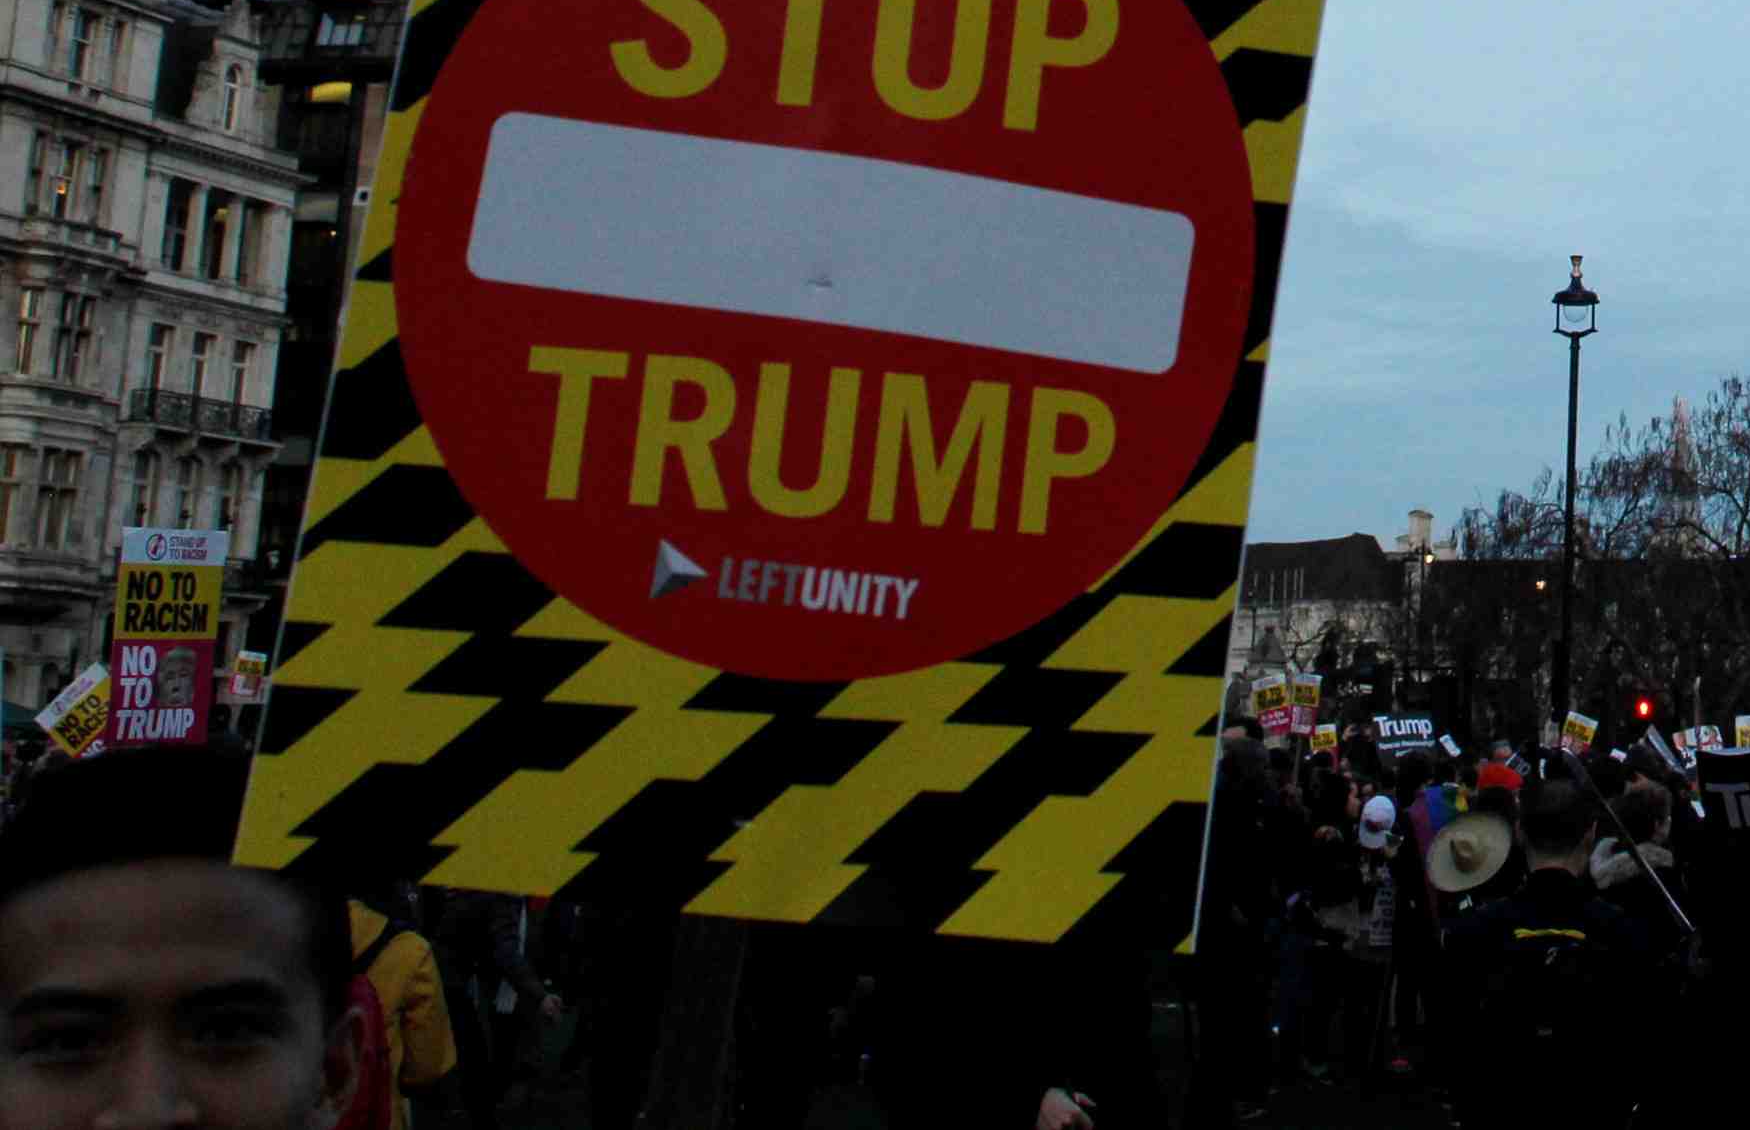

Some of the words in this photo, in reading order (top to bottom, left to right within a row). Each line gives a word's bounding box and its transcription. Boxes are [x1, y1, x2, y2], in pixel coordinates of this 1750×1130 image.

[528, 345, 1116, 534] TRUMP
[128, 571, 162, 600] NO
[173, 573, 196, 600] TO
[124, 603, 208, 632] RACISM
[121, 646, 157, 676] NO
[120, 678, 153, 708] TO
[56, 713, 79, 735] NO
[79, 694, 101, 715] TO
[68, 701, 109, 749] RACIS
[116, 709, 196, 742] TRUMP
[1372, 715, 1432, 739] Trump
